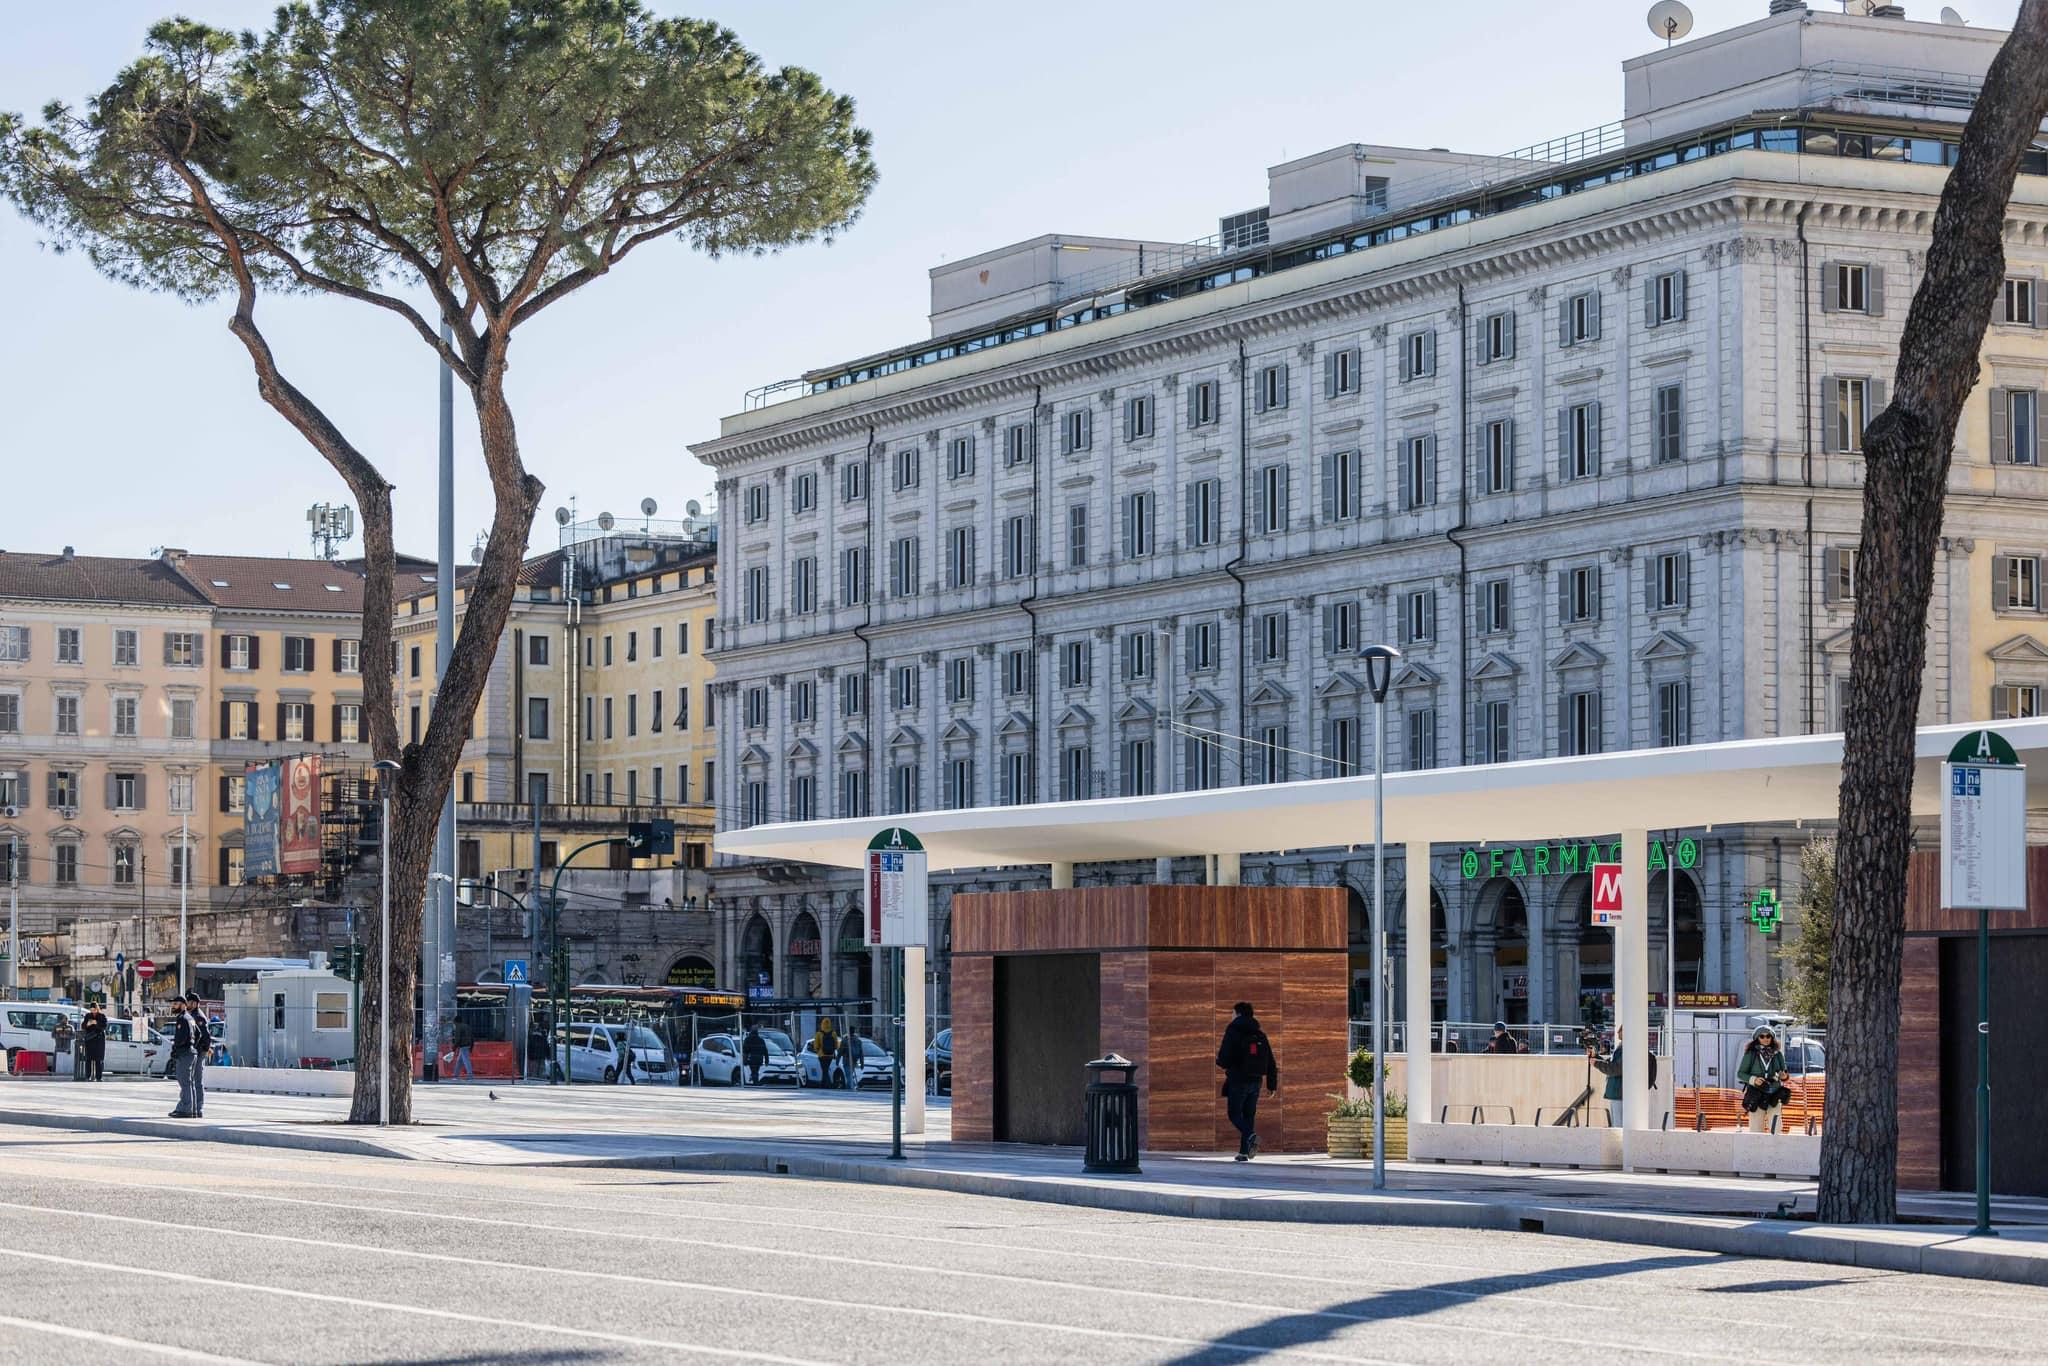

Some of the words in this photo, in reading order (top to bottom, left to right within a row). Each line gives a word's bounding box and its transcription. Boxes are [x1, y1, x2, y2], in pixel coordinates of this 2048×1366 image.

[1976, 730, 1992, 756] A
[891, 827, 902, 845] A
[1489, 839, 1667, 878] FARMACA
[1596, 872, 1622, 903] M
